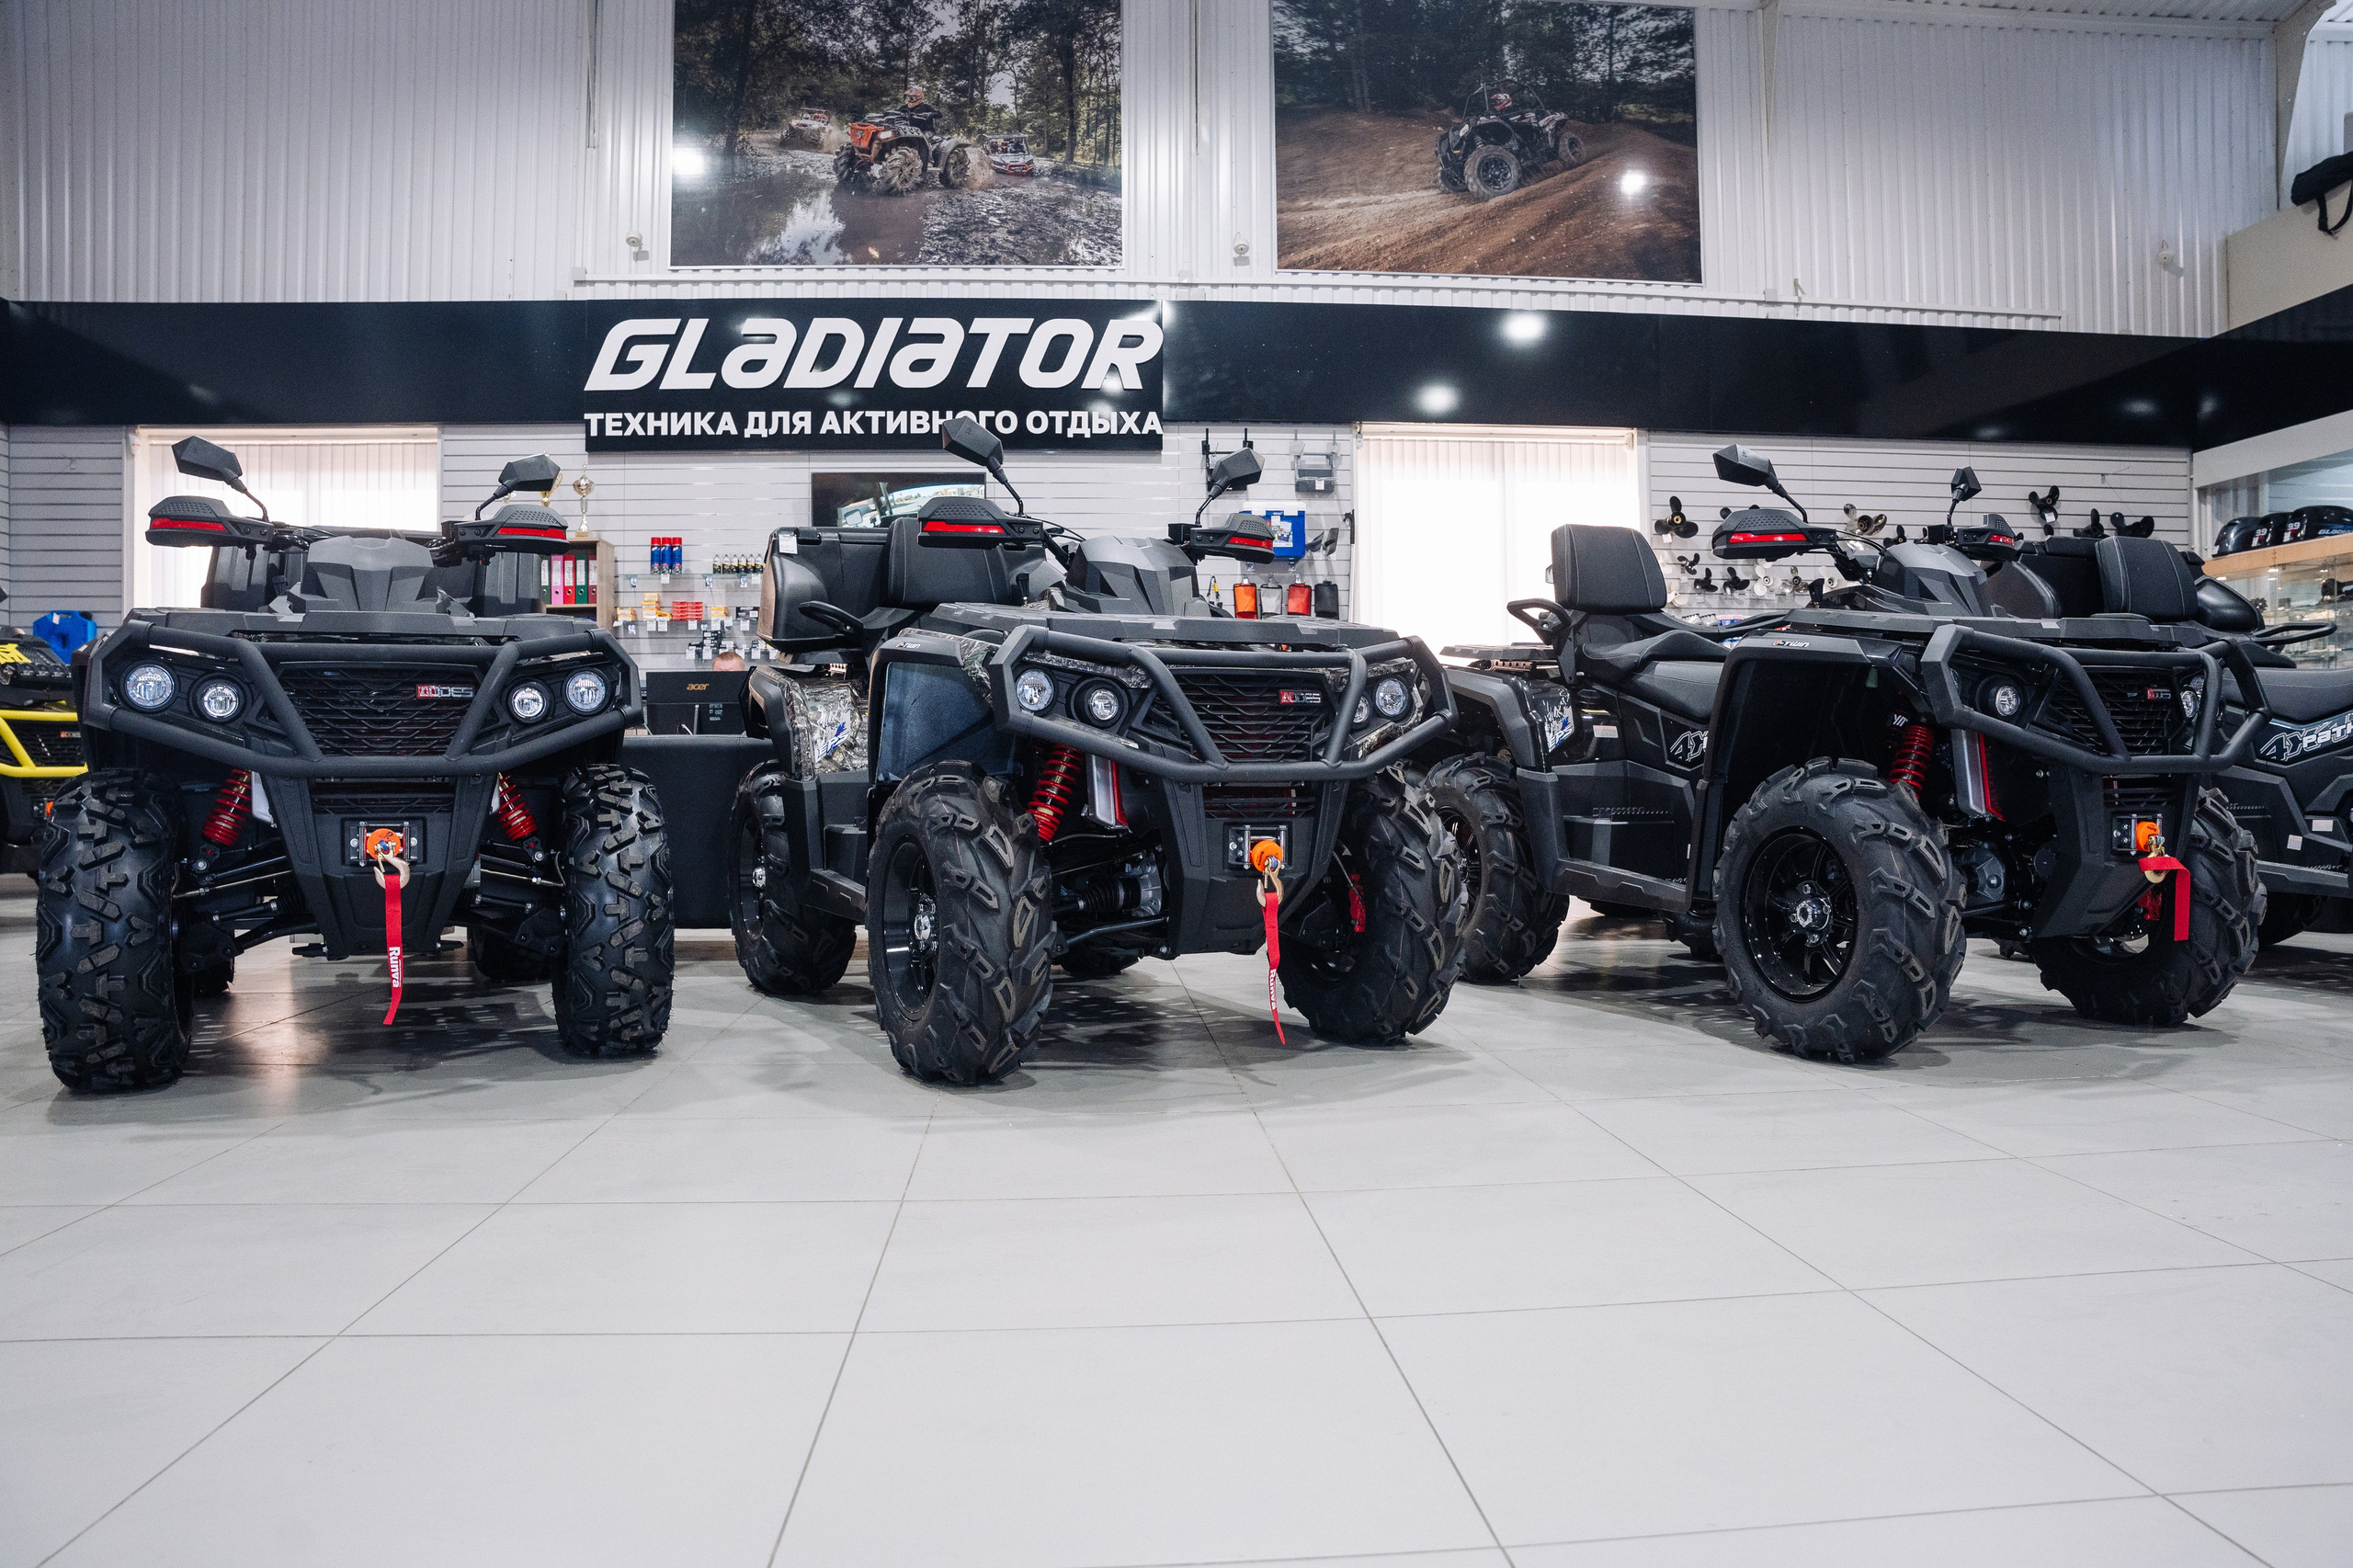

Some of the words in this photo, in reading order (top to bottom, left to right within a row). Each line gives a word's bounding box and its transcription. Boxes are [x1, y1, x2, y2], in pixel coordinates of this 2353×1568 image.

[584, 412, 738, 437] ТЕХНИКА
[744, 411, 813, 438] ДЛЯ
[1025, 410, 1164, 438] ОТДЫХА
[389, 946, 401, 988] Runva
